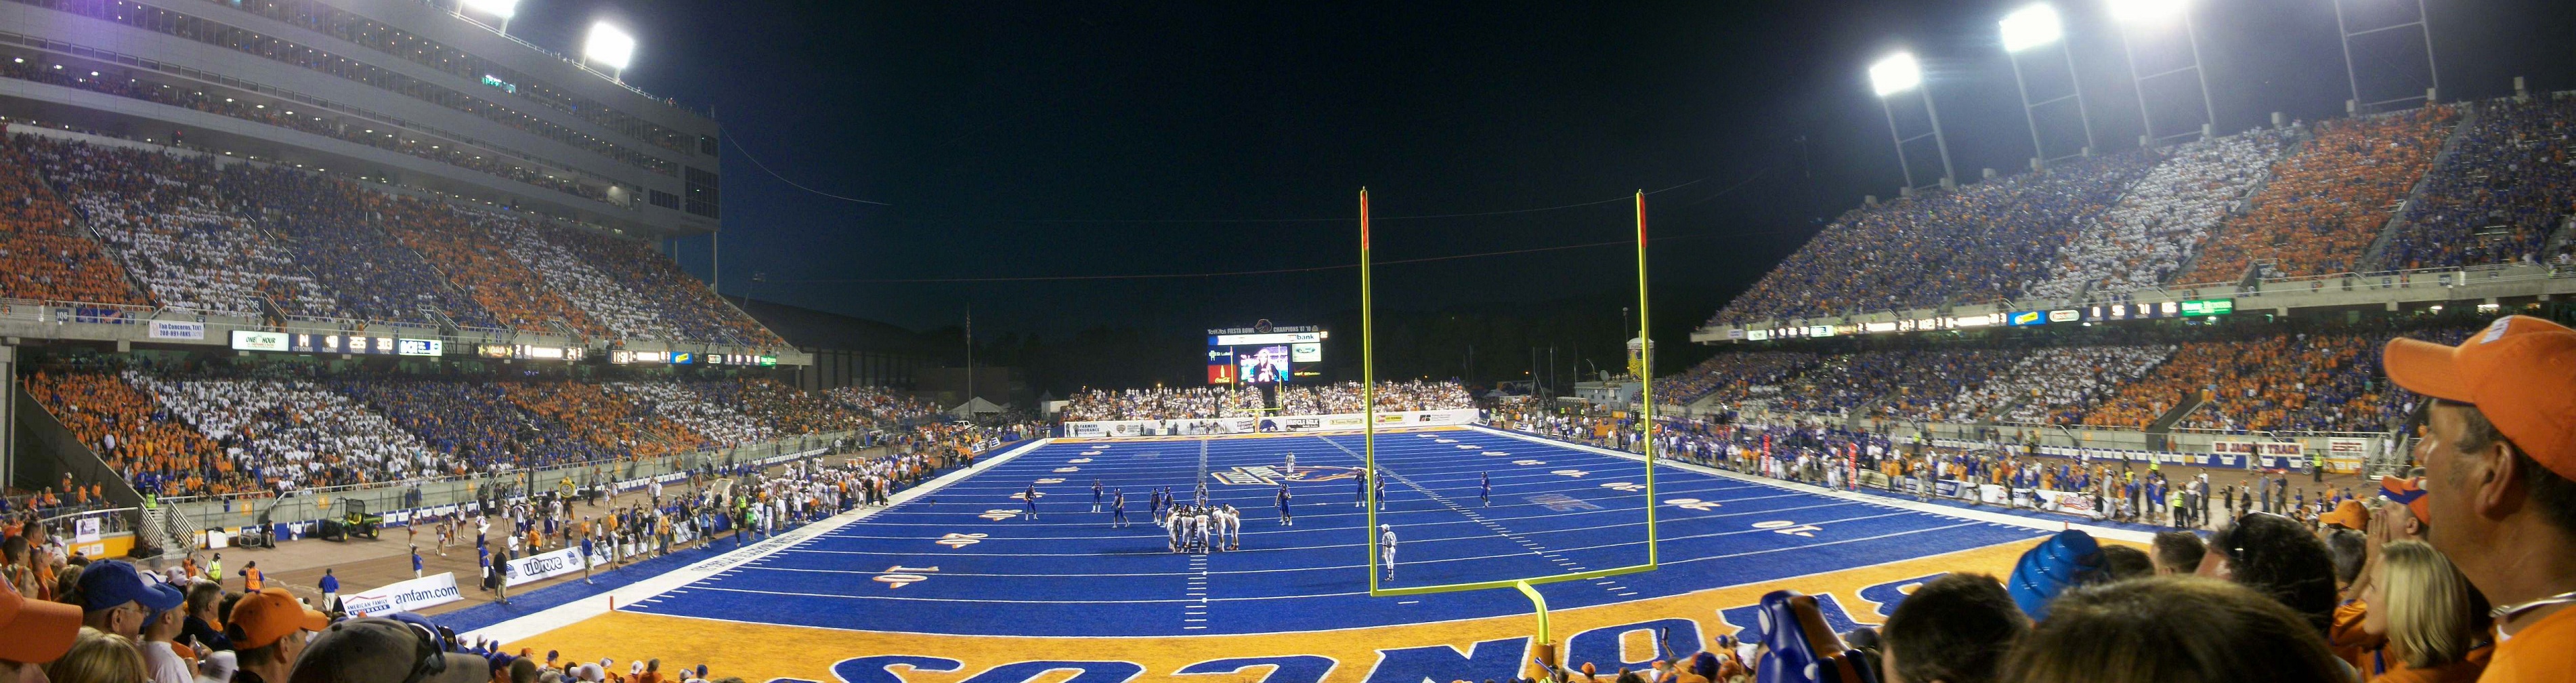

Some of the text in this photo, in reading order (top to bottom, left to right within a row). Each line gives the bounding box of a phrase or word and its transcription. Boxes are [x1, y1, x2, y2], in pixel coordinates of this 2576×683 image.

[1751, 520, 1823, 535] 10
[523, 556, 563, 576] uDrove
[872, 565, 940, 582] 10
[372, 599, 387, 607] FAMILY
[395, 585, 458, 604] amfam.com
